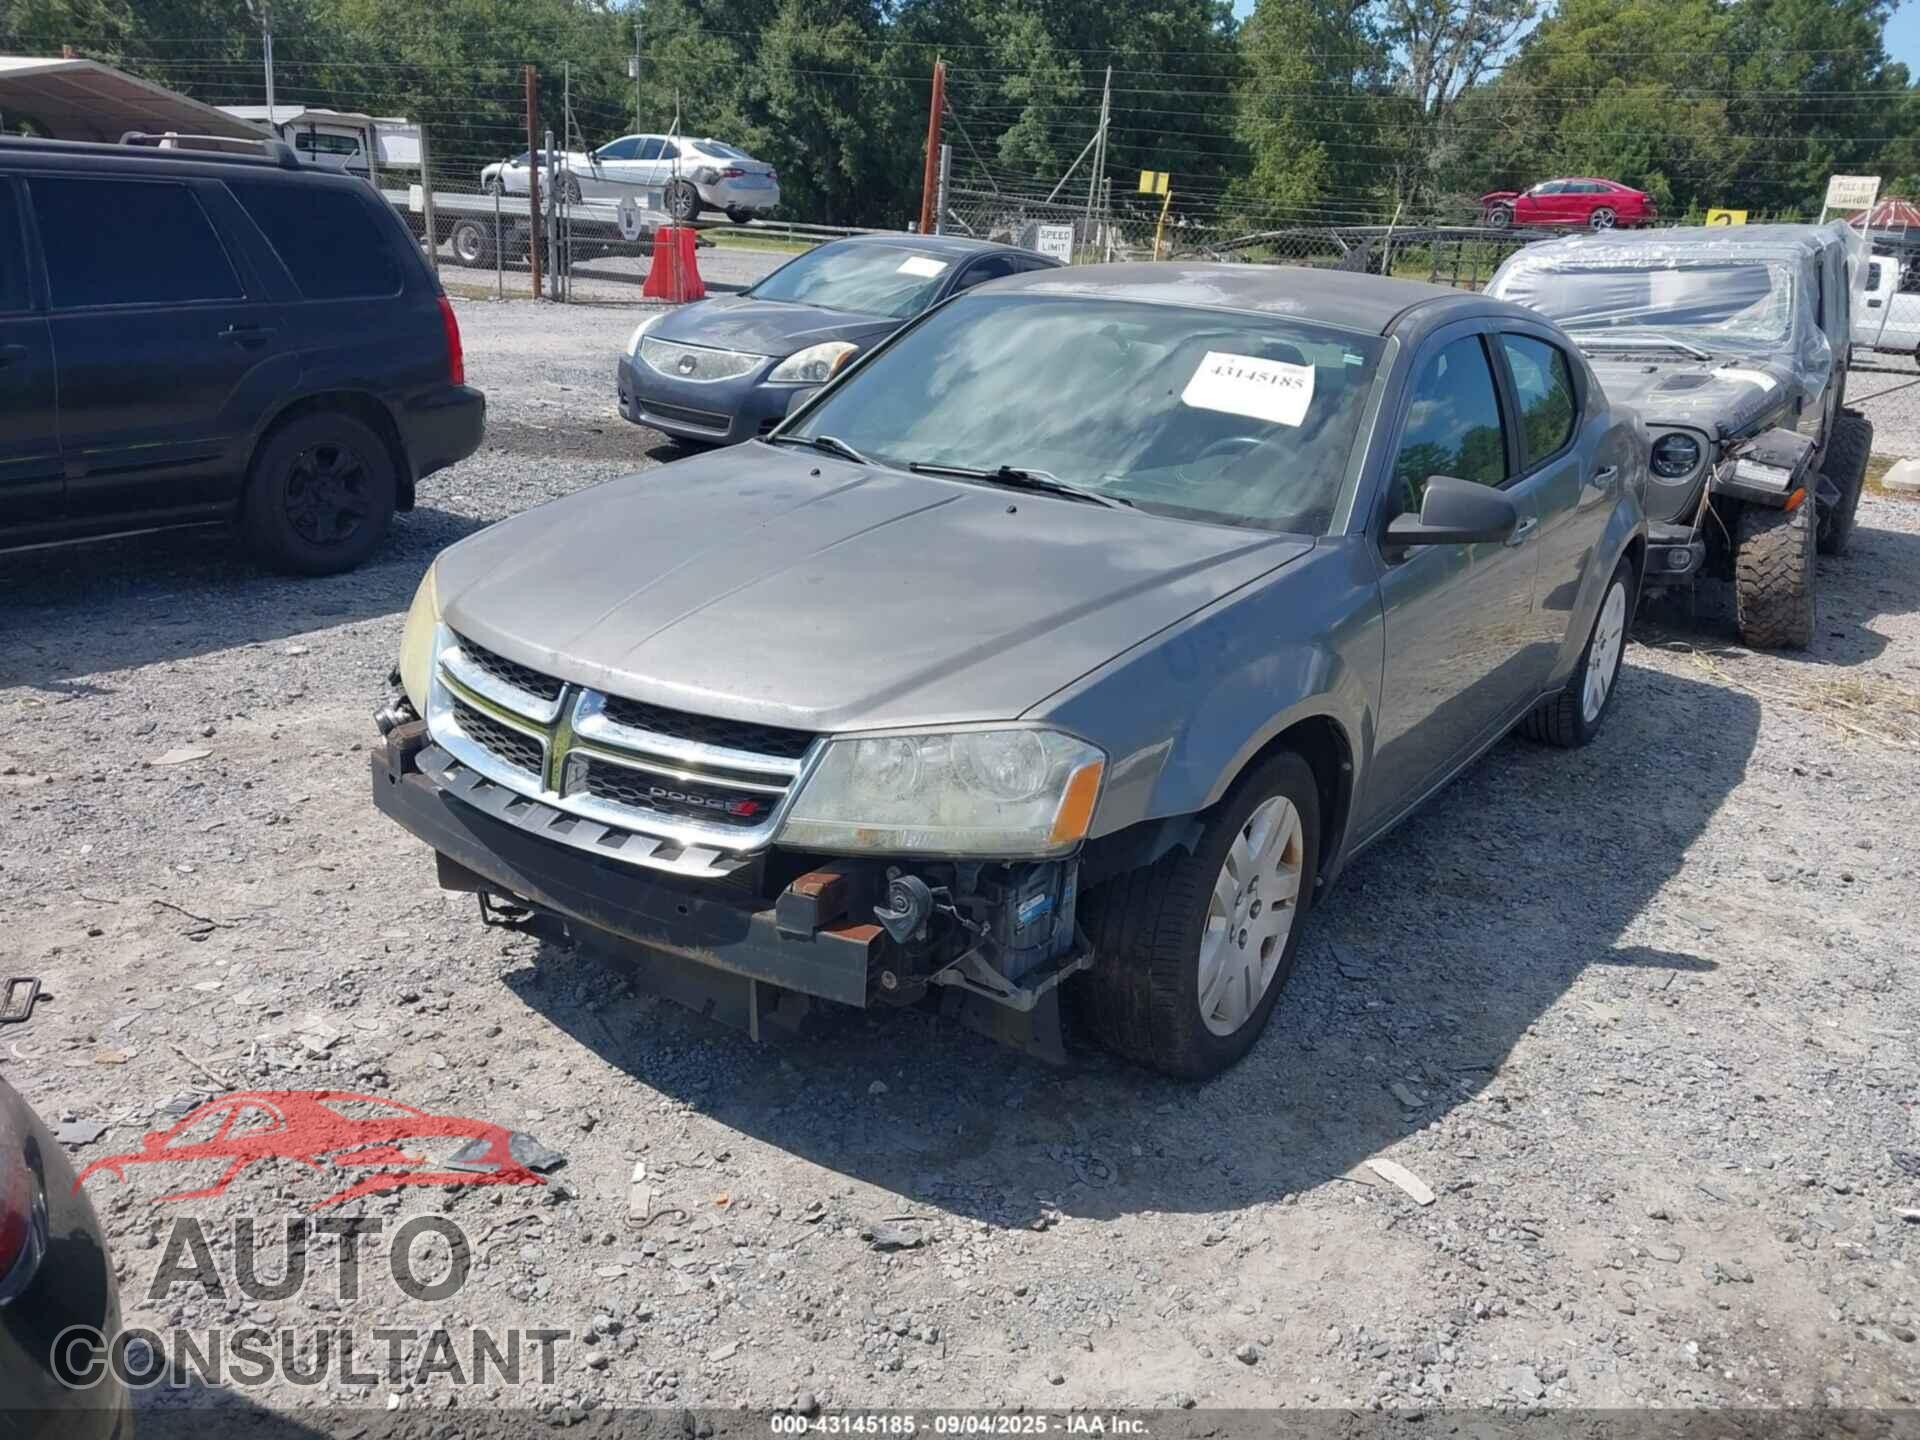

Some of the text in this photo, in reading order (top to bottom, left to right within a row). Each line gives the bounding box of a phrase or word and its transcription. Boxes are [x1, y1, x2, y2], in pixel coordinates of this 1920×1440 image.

[1040, 230, 1070, 241] SPEED
[1042, 242, 1066, 252] LIMIT
[1210, 365, 1305, 389] 43145185
[649, 786, 738, 813] DODGE
